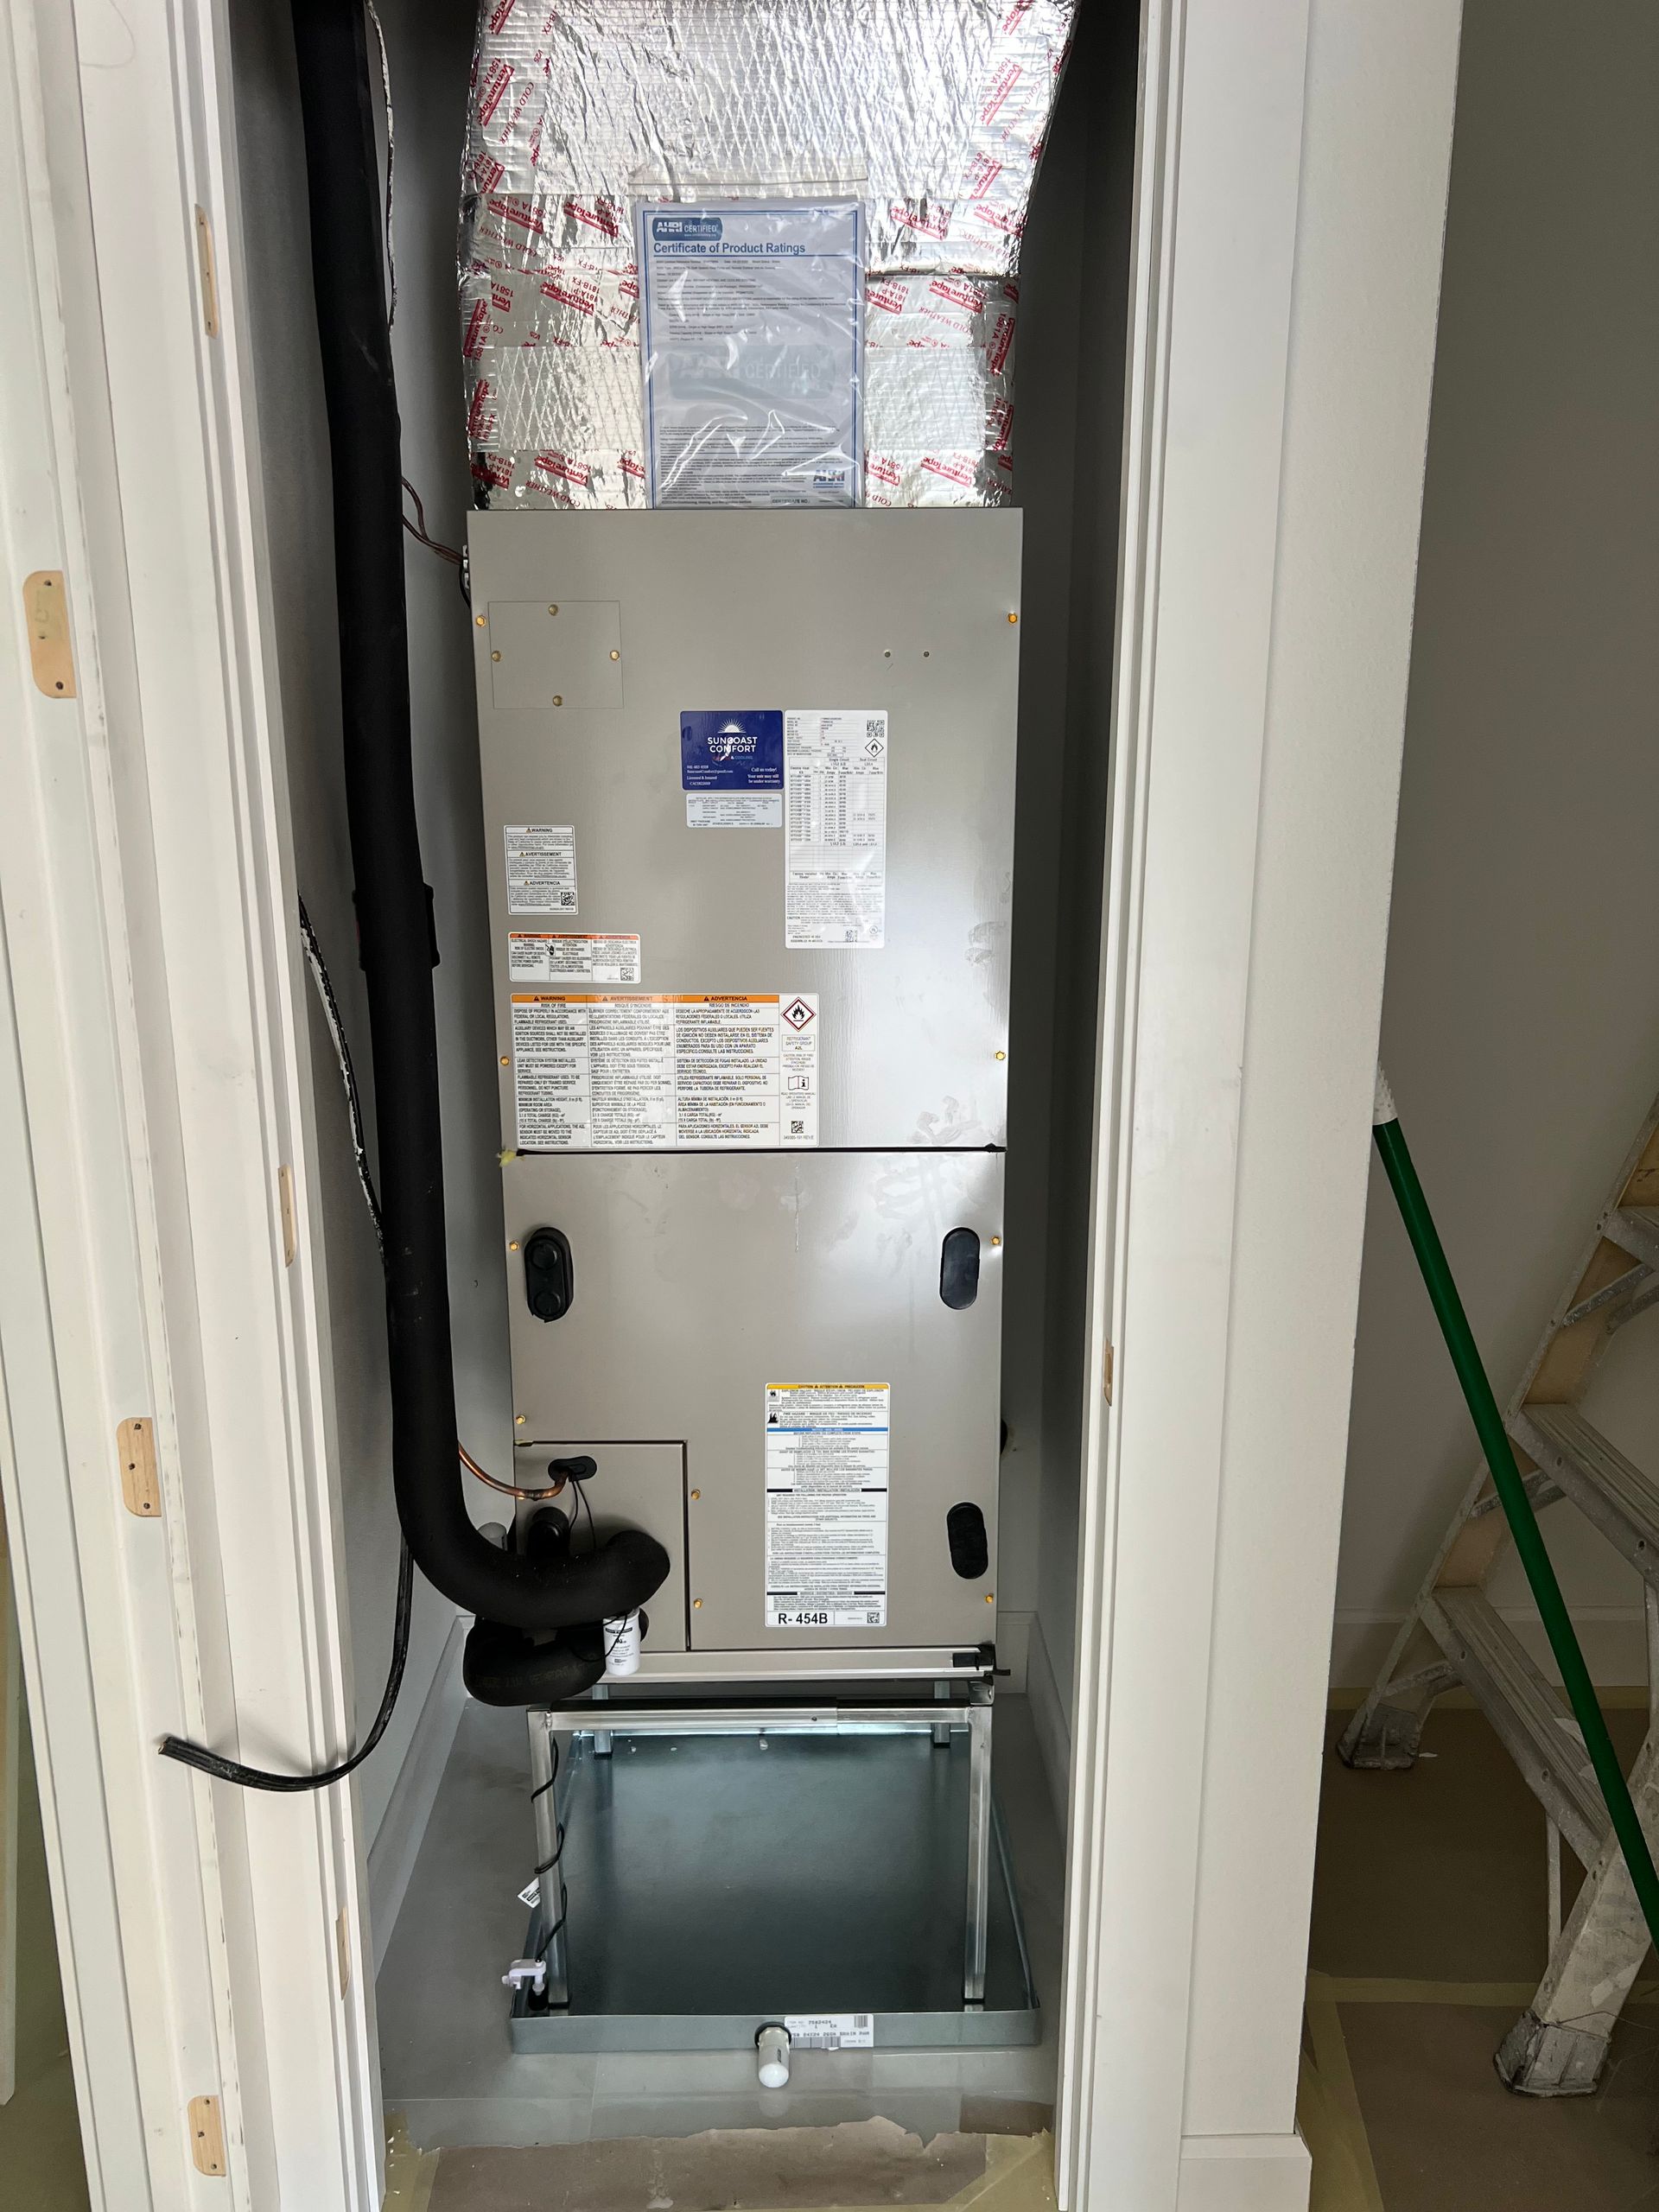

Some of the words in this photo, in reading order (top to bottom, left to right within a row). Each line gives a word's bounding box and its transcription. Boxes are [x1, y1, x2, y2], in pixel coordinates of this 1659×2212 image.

[483, 58, 501, 86] 1581A
[991, 57, 1014, 84] 1581A
[478, 63, 514, 126] VentureTape
[519, 82, 535, 106] COLD
[981, 63, 1020, 124] VentureTape
[489, 200, 544, 232] VentureTape
[522, 200, 547, 218] 1581A
[564, 201, 620, 233] VentureTape
[657, 221, 683, 233] AHRI
[653, 243, 707, 253] Certificate
[709, 243, 720, 253] of
[722, 243, 763, 253] Product
[766, 243, 805, 255] Ratings
[572, 276, 601, 293] 181B-FX
[573, 289, 599, 302] 181A-P
[880, 276, 909, 294] 181B-FX
[881, 289, 906, 302] 181A-P
[930, 280, 983, 309] VentureTape
[540, 281, 594, 312] VentureTape
[918, 307, 953, 327] WEATHER
[992, 313, 1007, 340] 1581A
[465, 300, 488, 357] VentureTape
[745, 362, 821, 380] CERTIFIED
[486, 454, 516, 469] 181B-FX
[535, 456, 588, 484] VentureTape
[921, 457, 973, 484] VentureTape
[525, 480, 562, 501] WEATHER
[561, 495, 581, 507] COLD
[778, 1612, 793, 1624] R-
[795, 1612, 828, 1624] 454B
